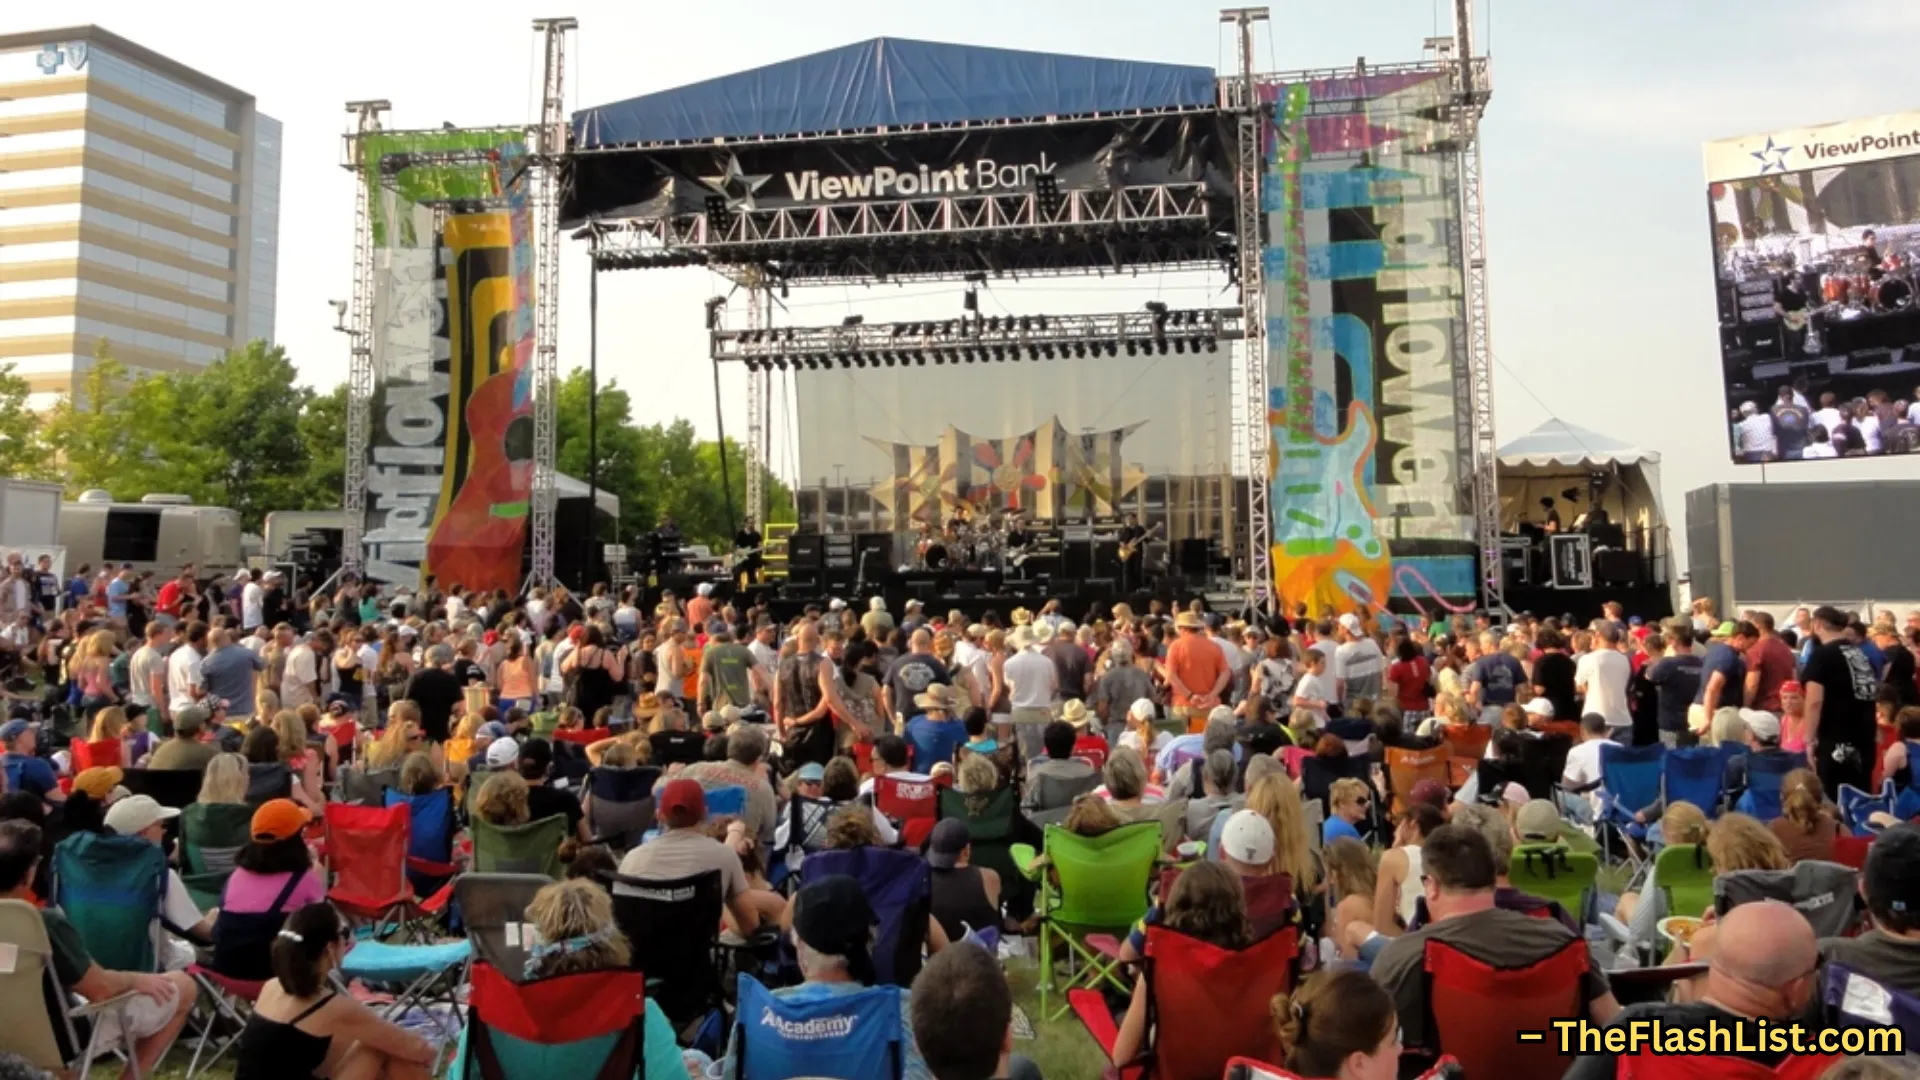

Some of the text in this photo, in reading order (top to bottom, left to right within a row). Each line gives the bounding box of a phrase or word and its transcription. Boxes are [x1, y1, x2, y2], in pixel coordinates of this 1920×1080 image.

[1803, 130, 1920, 160] ViewPoint
[785, 151, 1065, 201] ViewPoint Bank
